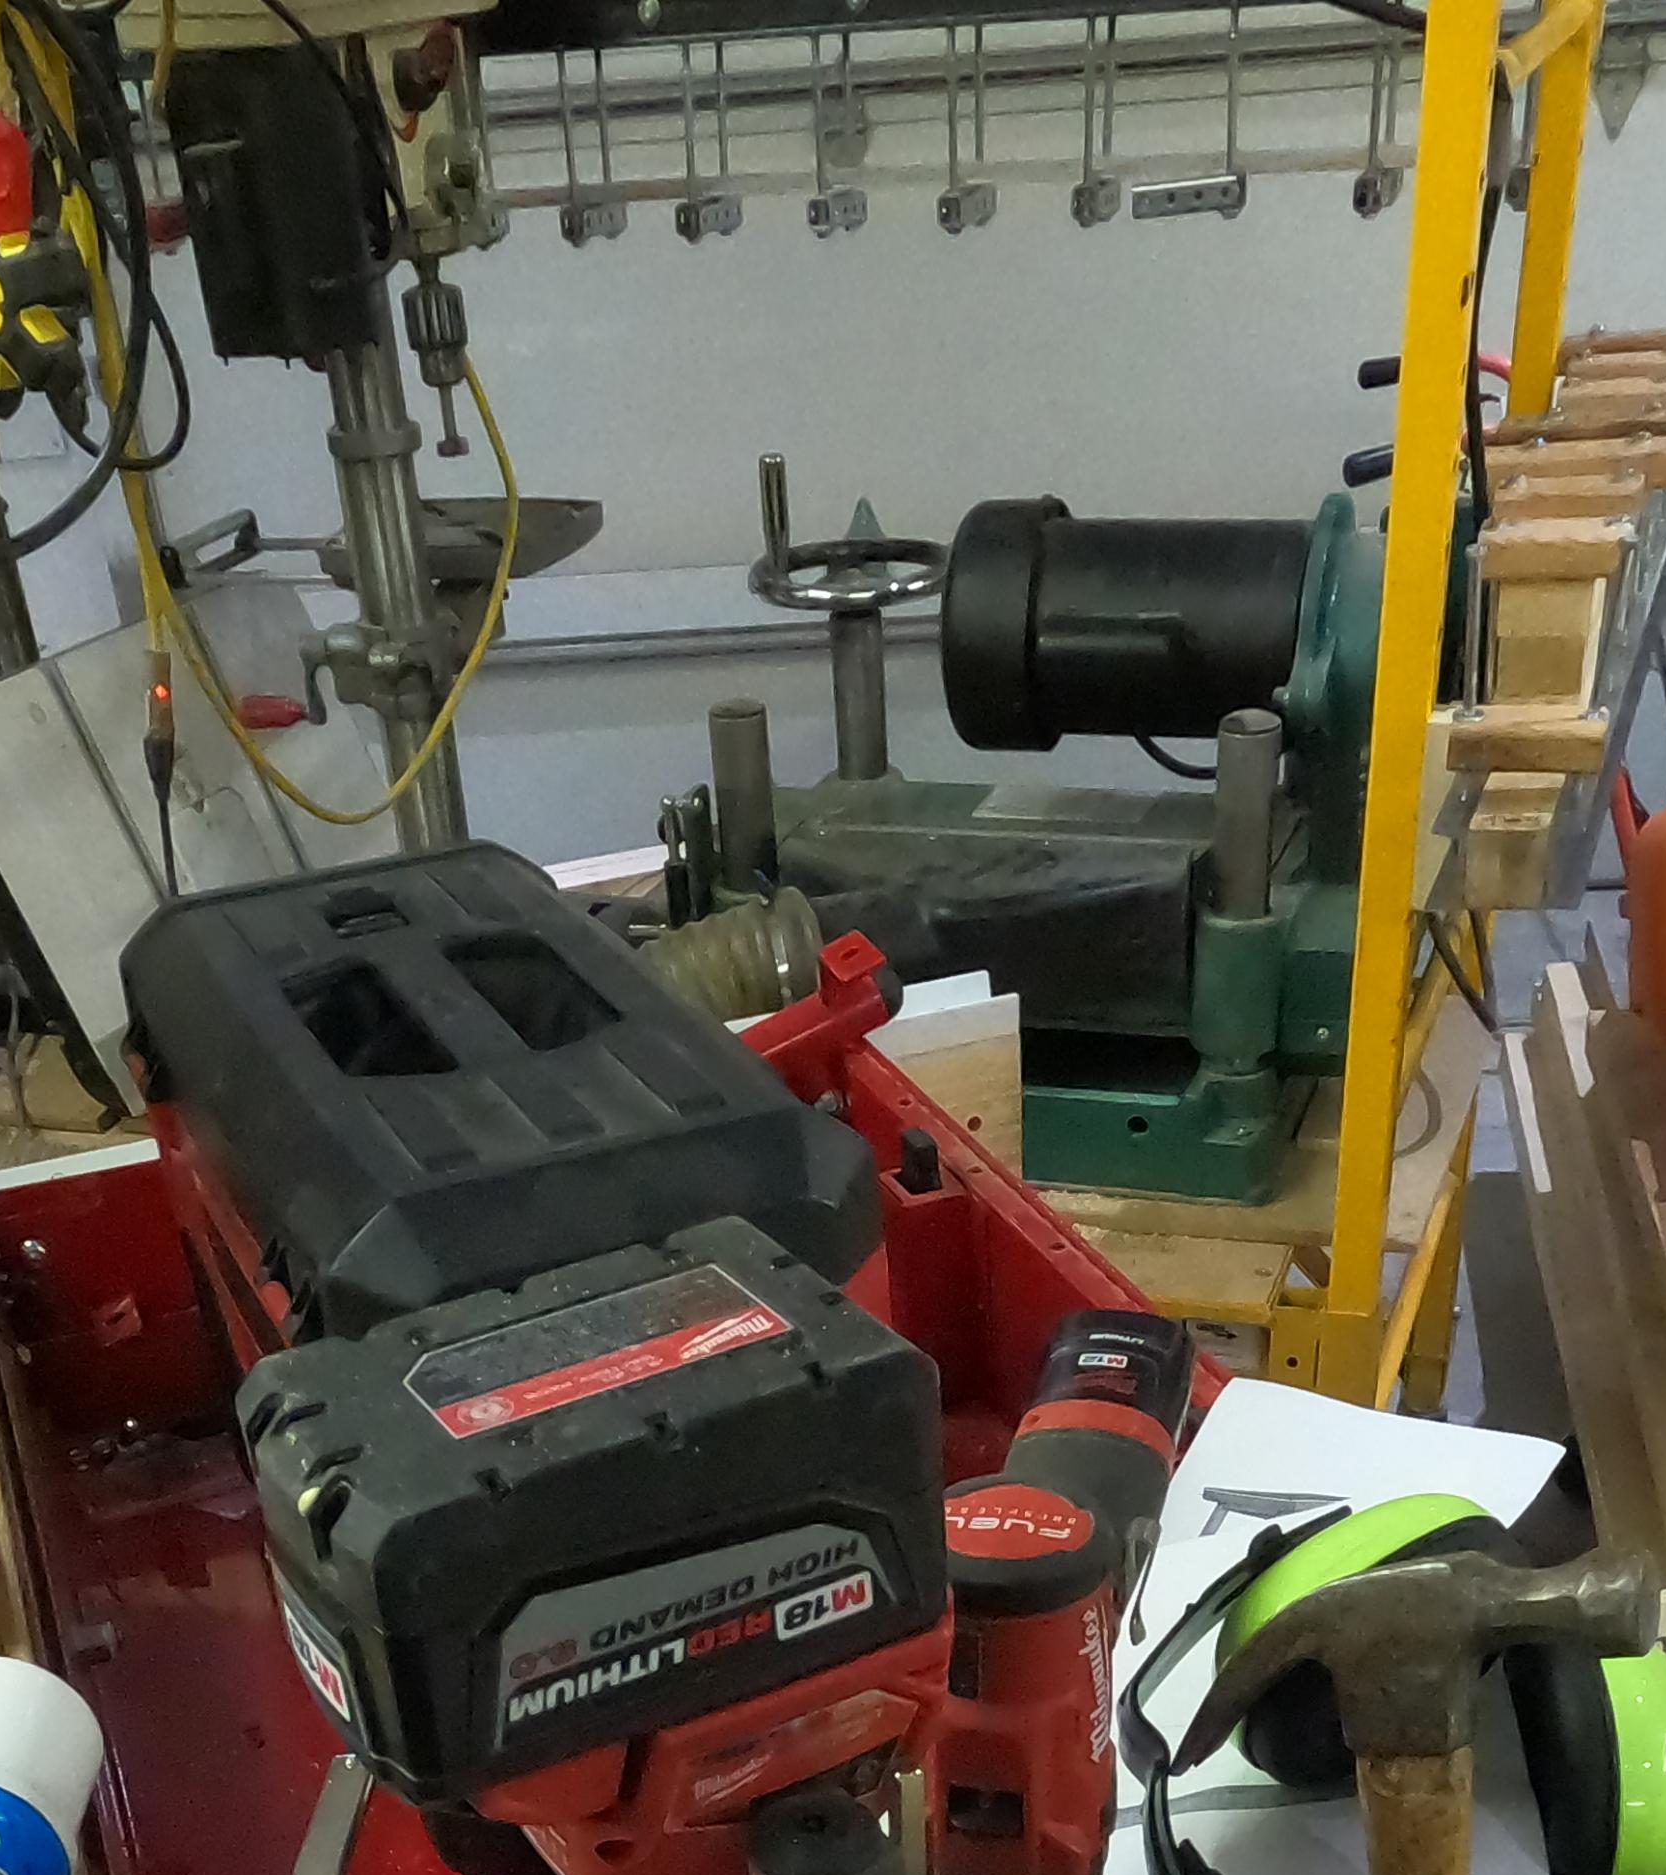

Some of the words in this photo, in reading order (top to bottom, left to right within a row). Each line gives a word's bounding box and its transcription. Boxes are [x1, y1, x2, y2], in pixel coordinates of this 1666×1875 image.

[946, 1516, 1071, 1540] FUEL
[767, 1537, 860, 1587] HIGH
[589, 1574, 756, 1651] DEMAND
[782, 1577, 867, 1632] M18
[1078, 1604, 1110, 1763] Milwaukee
